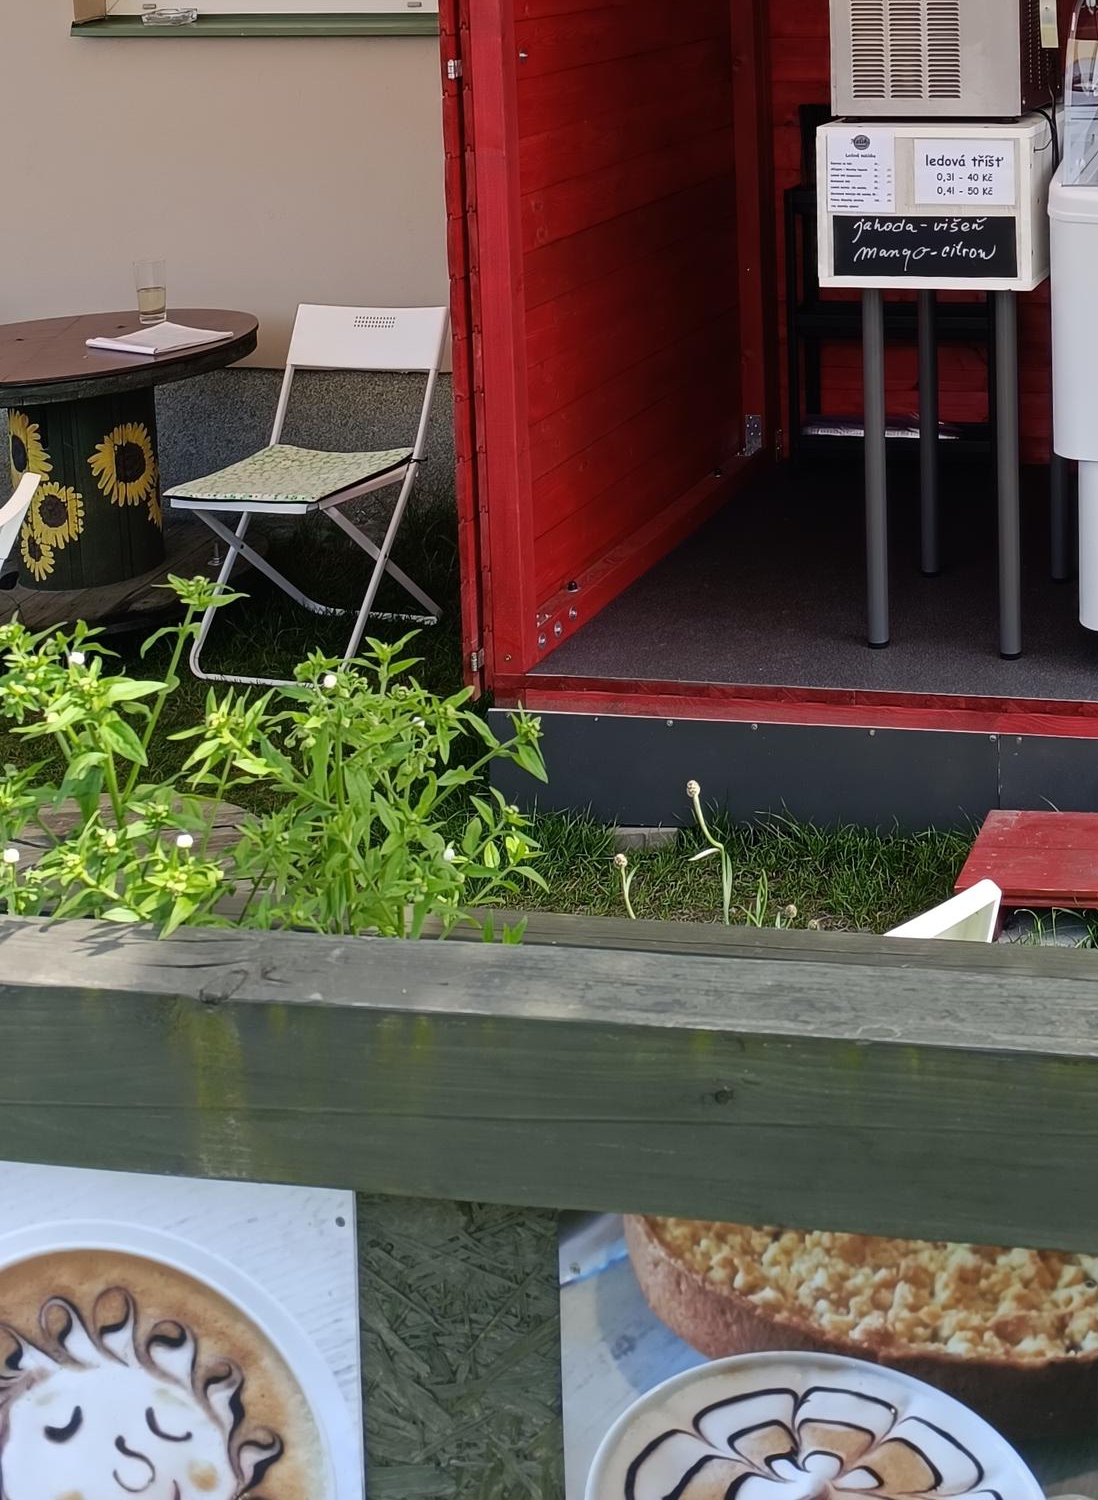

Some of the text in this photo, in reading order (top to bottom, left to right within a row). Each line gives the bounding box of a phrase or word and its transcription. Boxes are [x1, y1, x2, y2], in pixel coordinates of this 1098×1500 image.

[925, 153, 1004, 167] ledová tříšť
[936, 172, 955, 182] 0,3l
[967, 173, 979, 182] 40
[982, 172, 993, 182] Kč
[936, 186, 955, 196] 0,4l
[967, 186, 979, 196] 50
[982, 186, 993, 196] Kč
